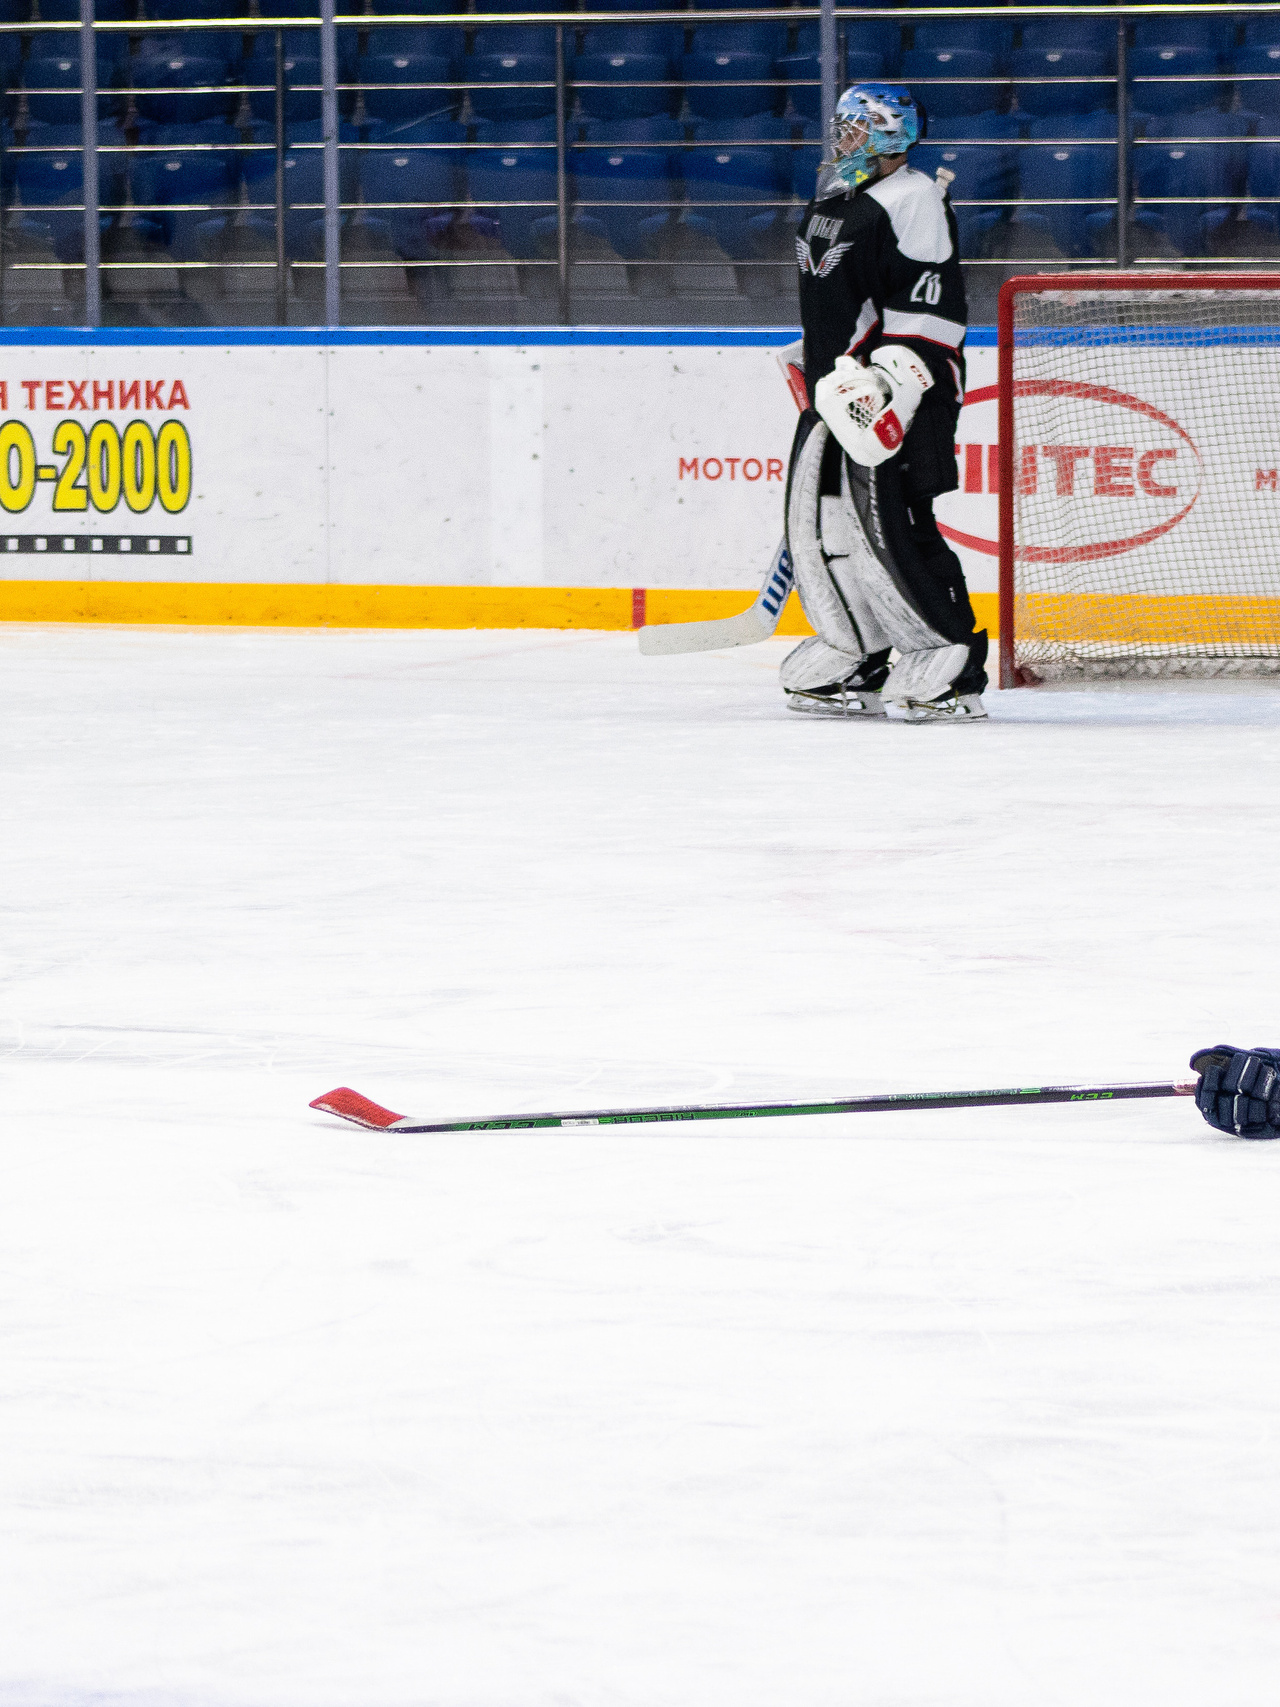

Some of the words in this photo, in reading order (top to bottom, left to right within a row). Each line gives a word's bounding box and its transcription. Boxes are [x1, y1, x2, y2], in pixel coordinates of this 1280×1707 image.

[21, 380, 191, 411] ТЕХНИКА
[678, 457, 784, 482] MOTOR
[954, 443, 1178, 498] INTEC
[1070, 1091, 1114, 1101] CCM
[467, 1119, 537, 1131] CCM
